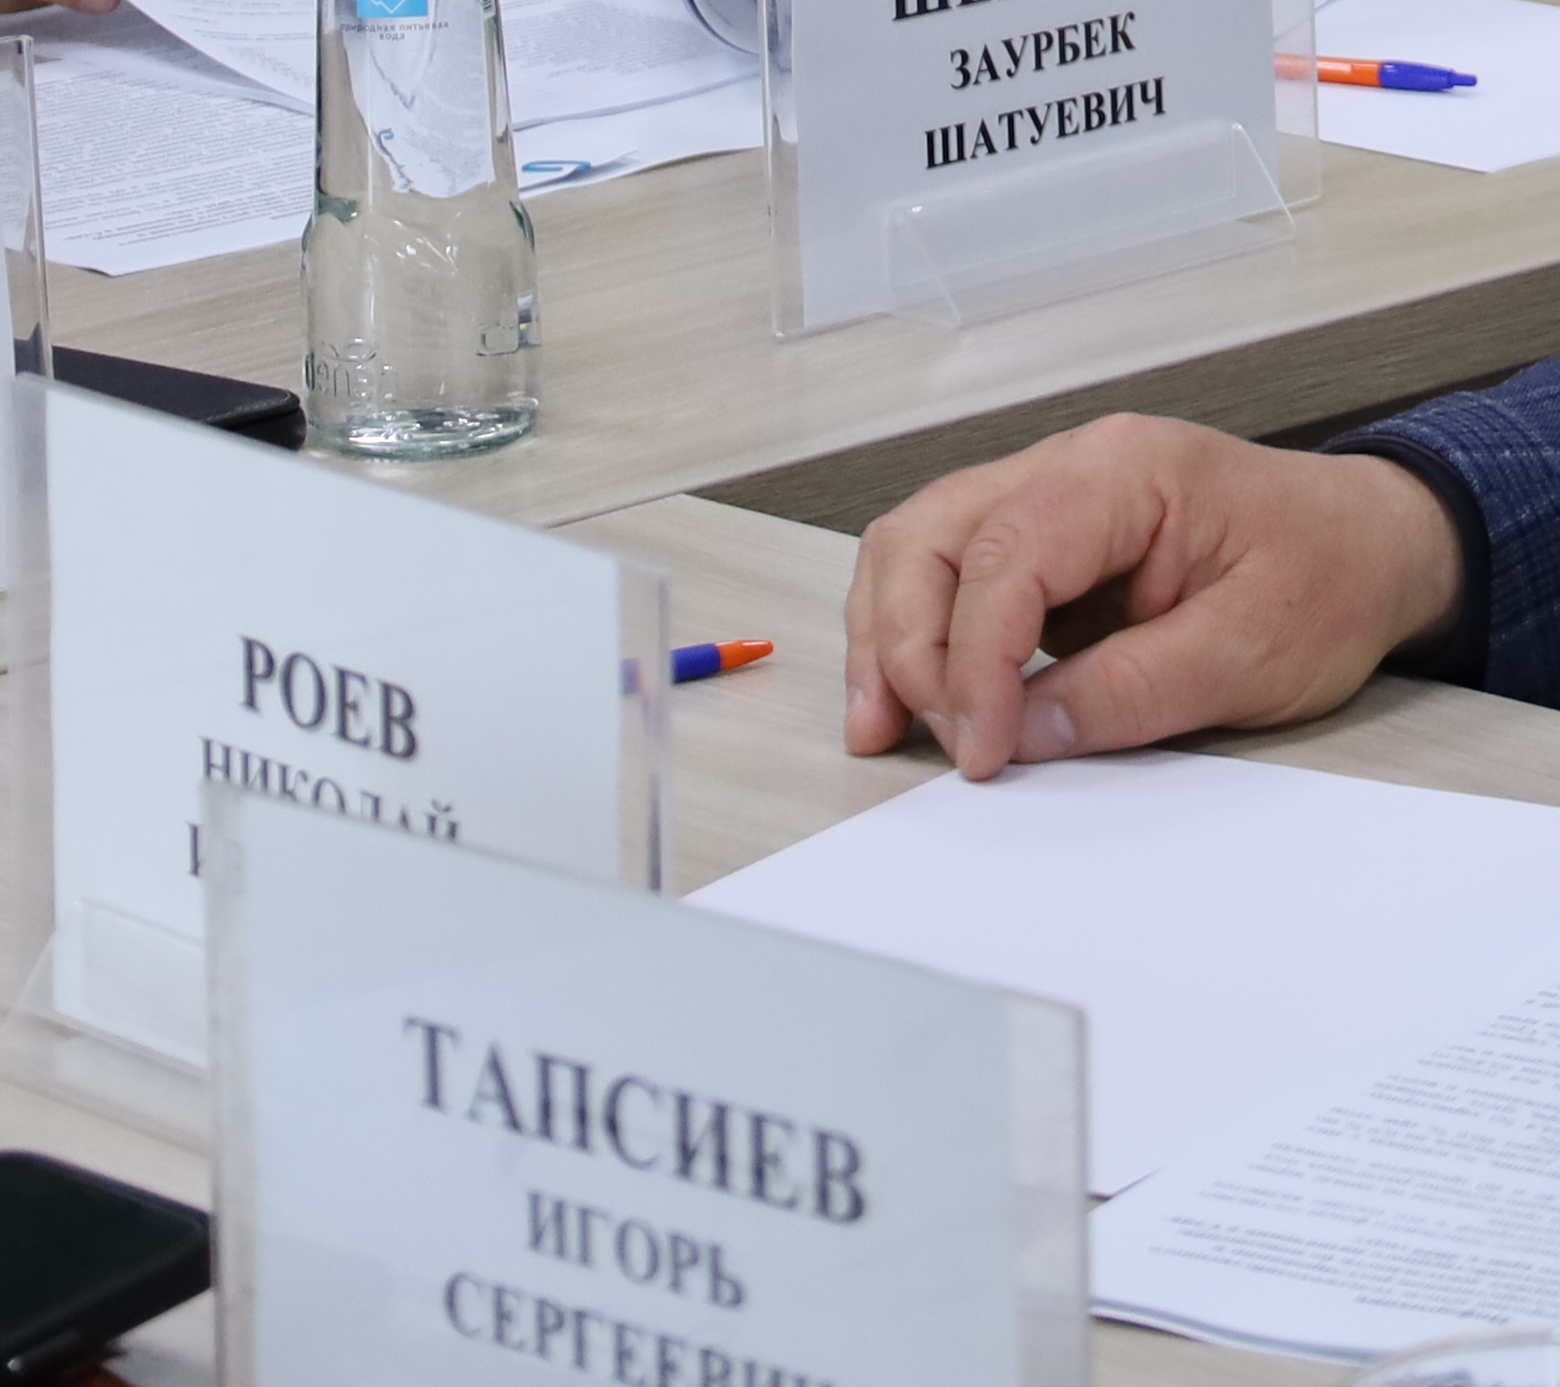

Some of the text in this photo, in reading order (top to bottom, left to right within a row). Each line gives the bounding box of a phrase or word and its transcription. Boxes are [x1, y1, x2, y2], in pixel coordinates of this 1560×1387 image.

[340, 21, 449, 33] природная питьевая
[379, 32, 406, 41] вода
[946, 12, 1136, 90] ЗАУРБЕК
[922, 78, 1164, 170] ШАТУЕВИЧ
[239, 636, 419, 767] РОЕВ
[418, 1020, 869, 1232] ТАПСИЕВ
[523, 1189, 748, 1314] ИГОРЬ
[442, 1270, 837, 1387] СЕРГЕЕВ
